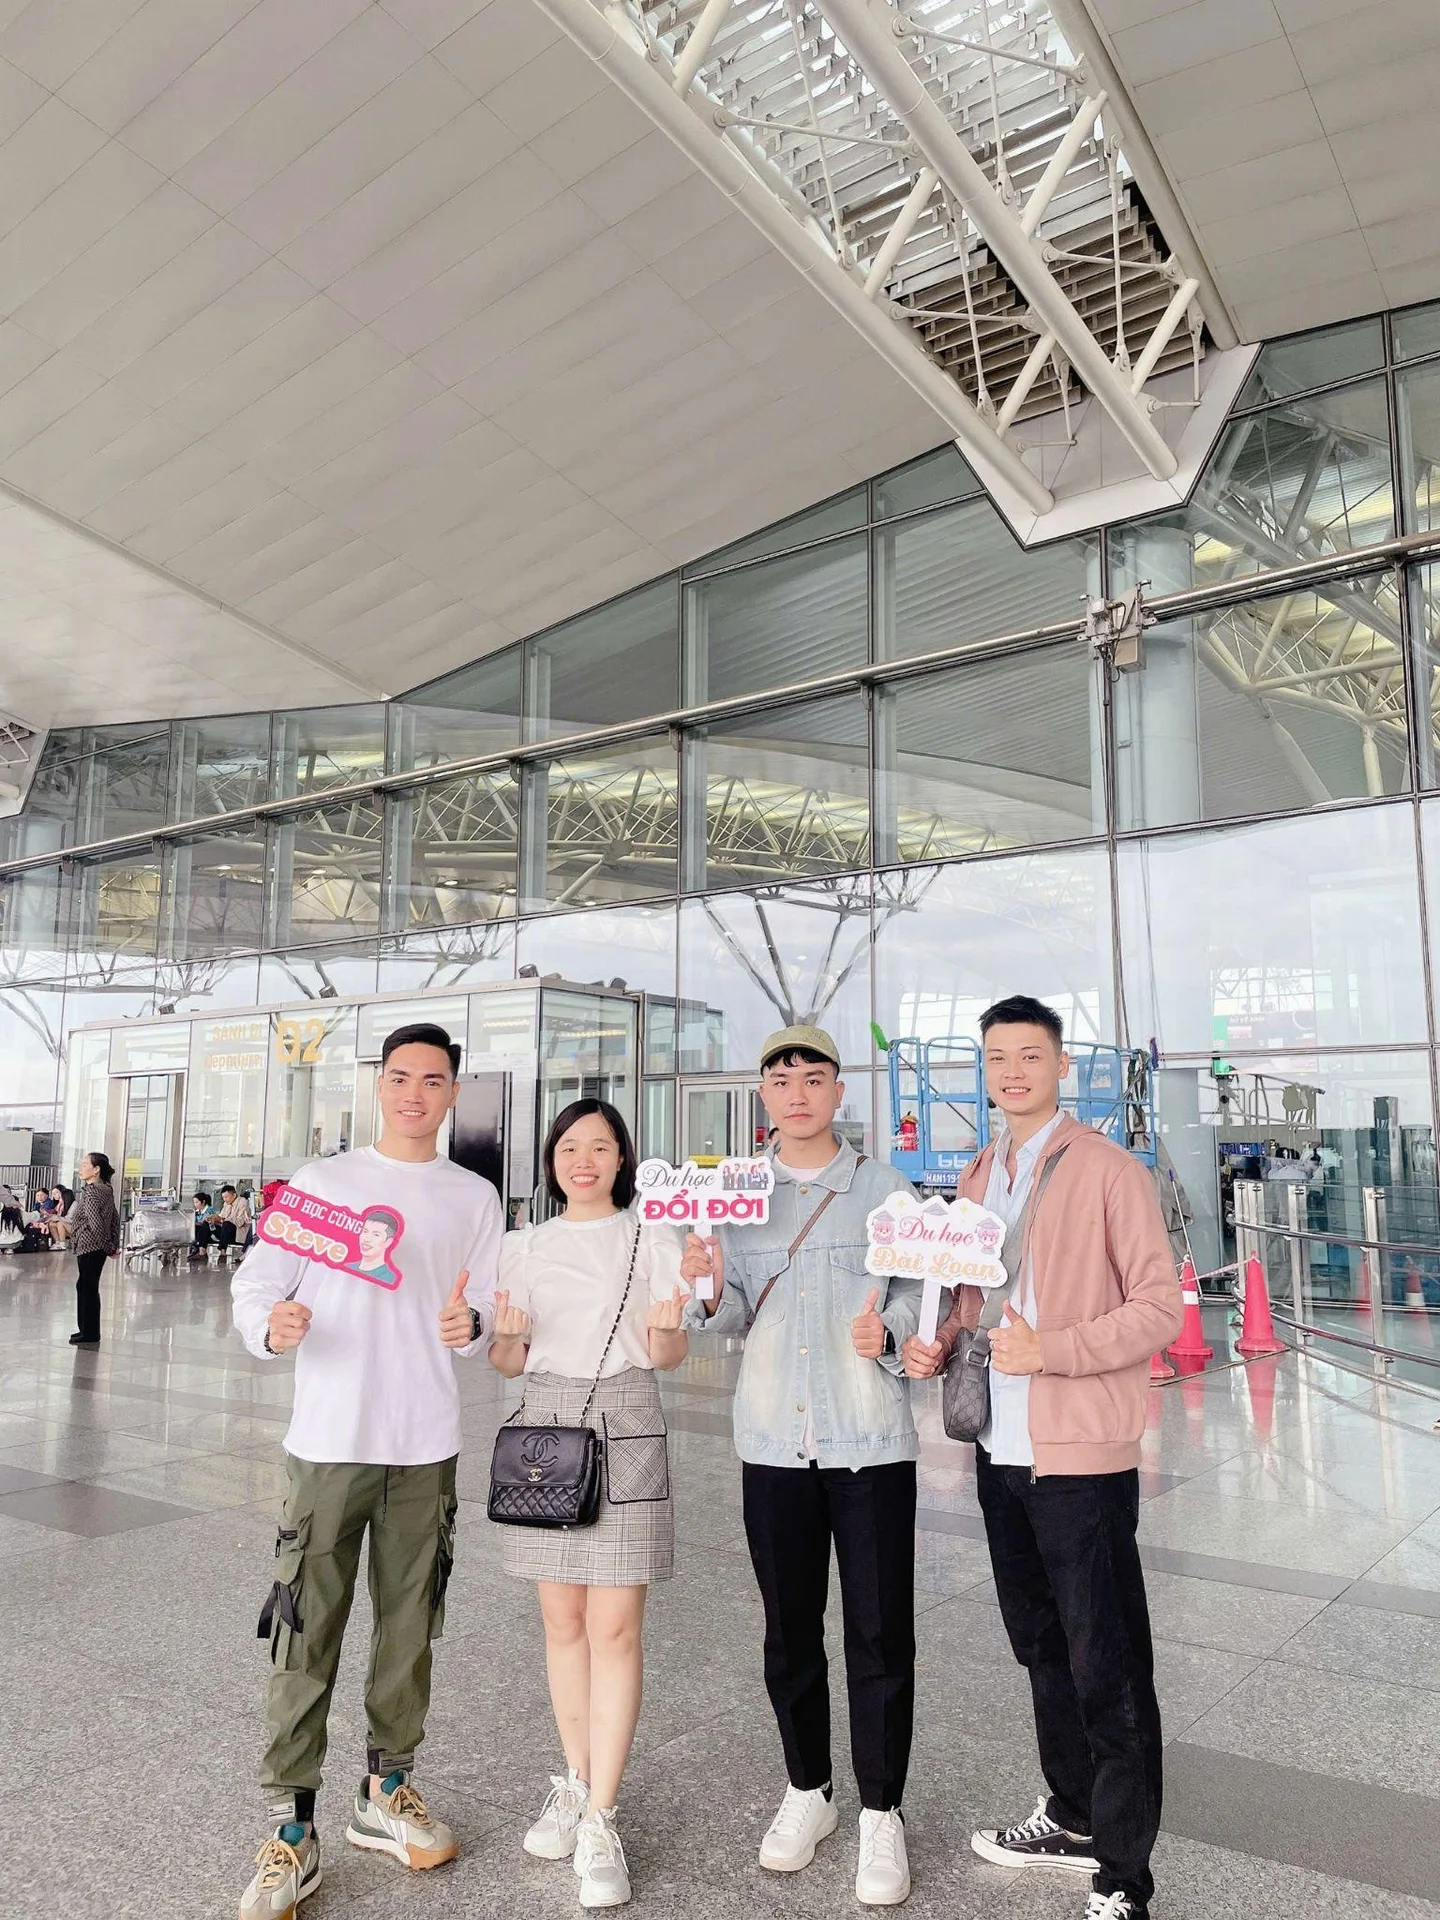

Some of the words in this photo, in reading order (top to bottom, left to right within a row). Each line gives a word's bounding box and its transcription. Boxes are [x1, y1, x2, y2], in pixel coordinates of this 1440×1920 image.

[642, 1164, 679, 1187] Du
[681, 1166, 715, 1189] học
[280, 1191, 301, 1208] DU
[301, 1199, 328, 1219] HỌC
[328, 1210, 363, 1234] CÙNG
[644, 1189, 698, 1220] ĐỔI
[707, 1193, 763, 1219] ĐỜI
[264, 1212, 348, 1262] Steve
[899, 1215, 935, 1240] Du
[936, 1222, 974, 1247] học
[873, 1246, 924, 1270] Đài
[928, 1252, 999, 1279] Loan
